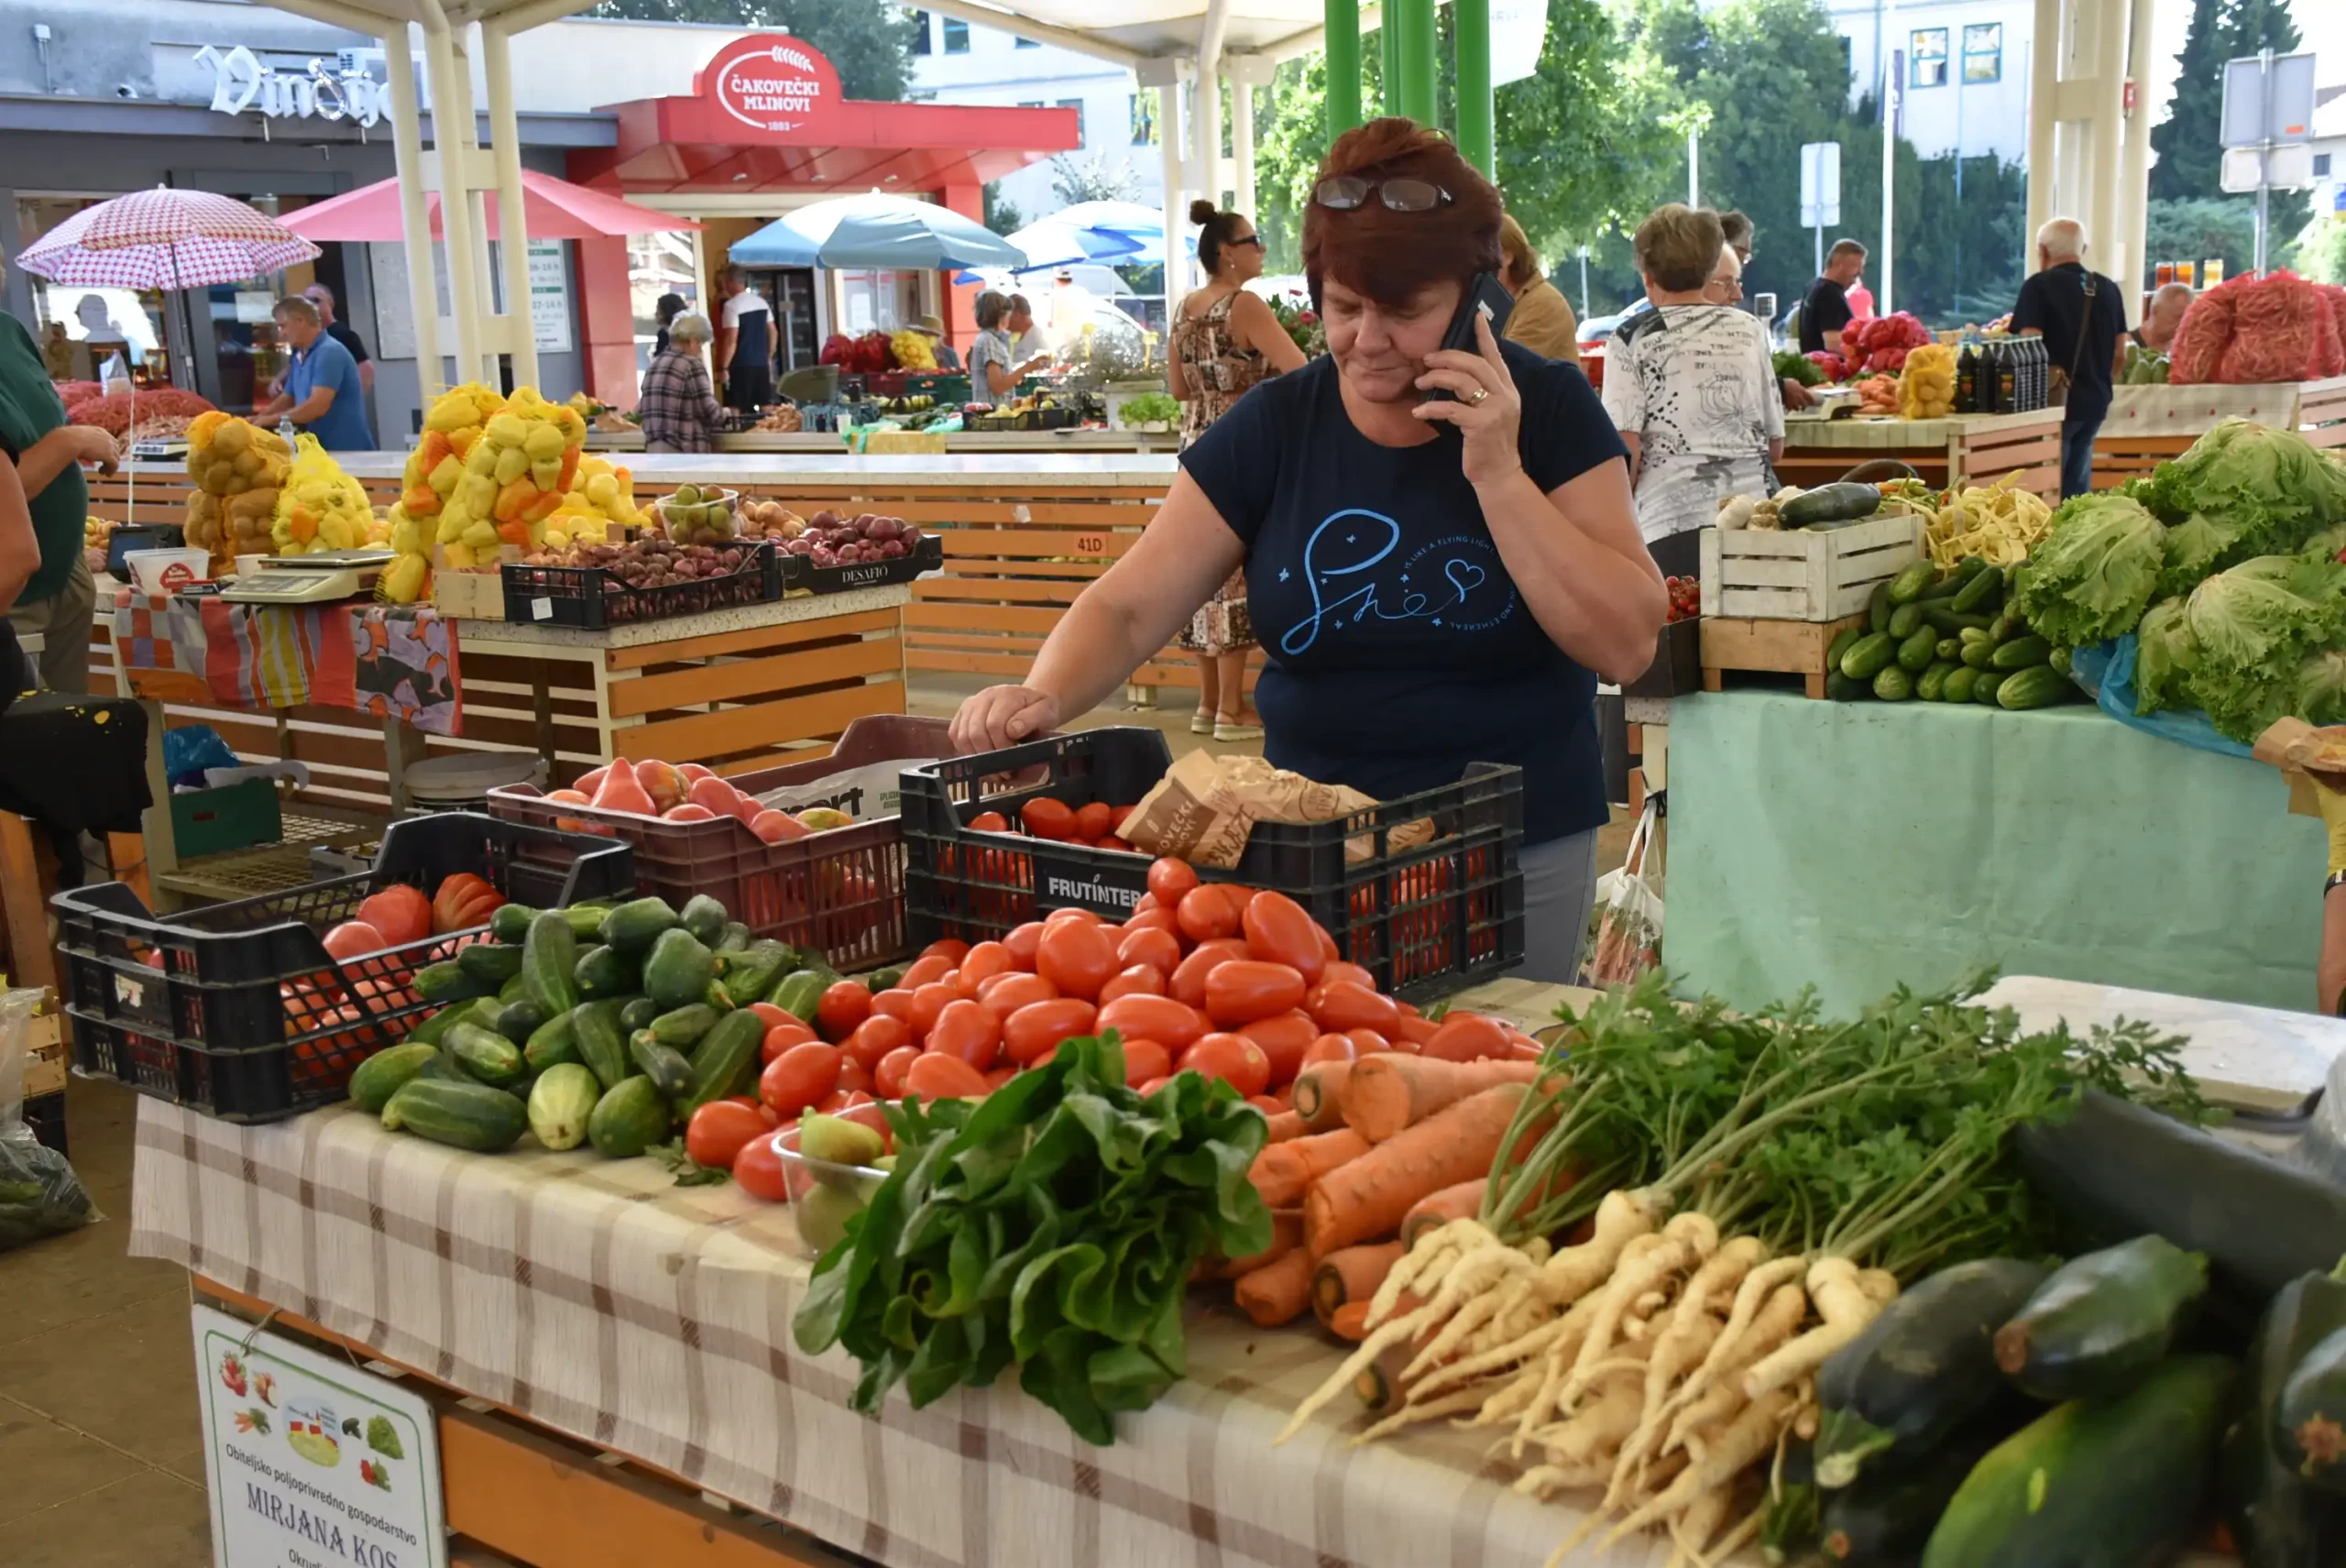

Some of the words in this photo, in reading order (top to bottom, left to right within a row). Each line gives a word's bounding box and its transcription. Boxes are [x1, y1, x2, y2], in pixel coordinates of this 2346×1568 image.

[730, 73, 820, 96] ČAKOVEČKI
[743, 95, 811, 112] MLINOVI
[1078, 537, 1102, 552] 41D
[1410, 547, 1427, 562] LIKE
[1437, 535, 1468, 546] FLYING
[226, 1443, 272, 1476] Obiteljsko
[274, 1468, 345, 1512] poljoprivredno
[347, 1504, 417, 1547] gospodarstvo
[247, 1481, 347, 1559] MIRJANA
